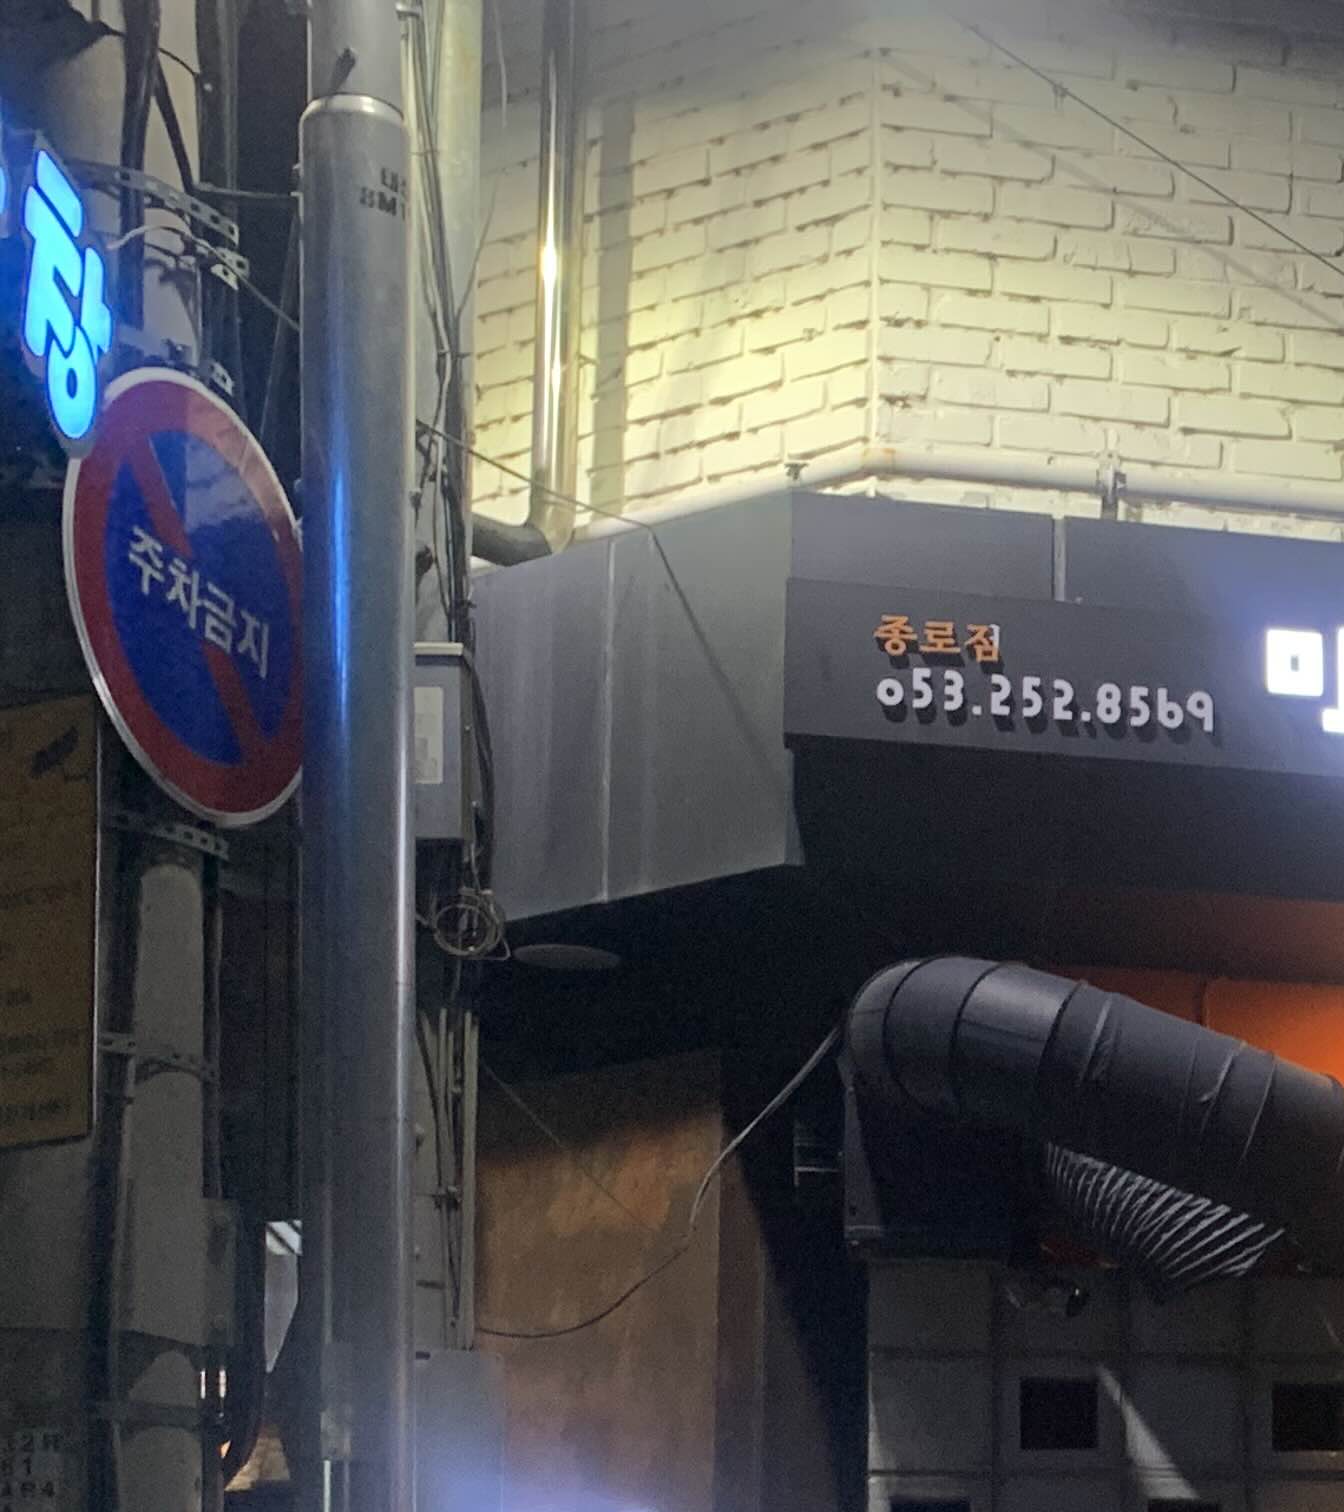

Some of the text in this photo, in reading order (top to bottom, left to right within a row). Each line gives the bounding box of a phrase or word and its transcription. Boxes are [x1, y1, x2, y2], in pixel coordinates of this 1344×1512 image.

[0, 150, 112, 438] 창
[128, 526, 270, 681] 주차금지
[872, 612, 1001, 662] 종로점
[875, 666, 1214, 734] 053.252.8569
